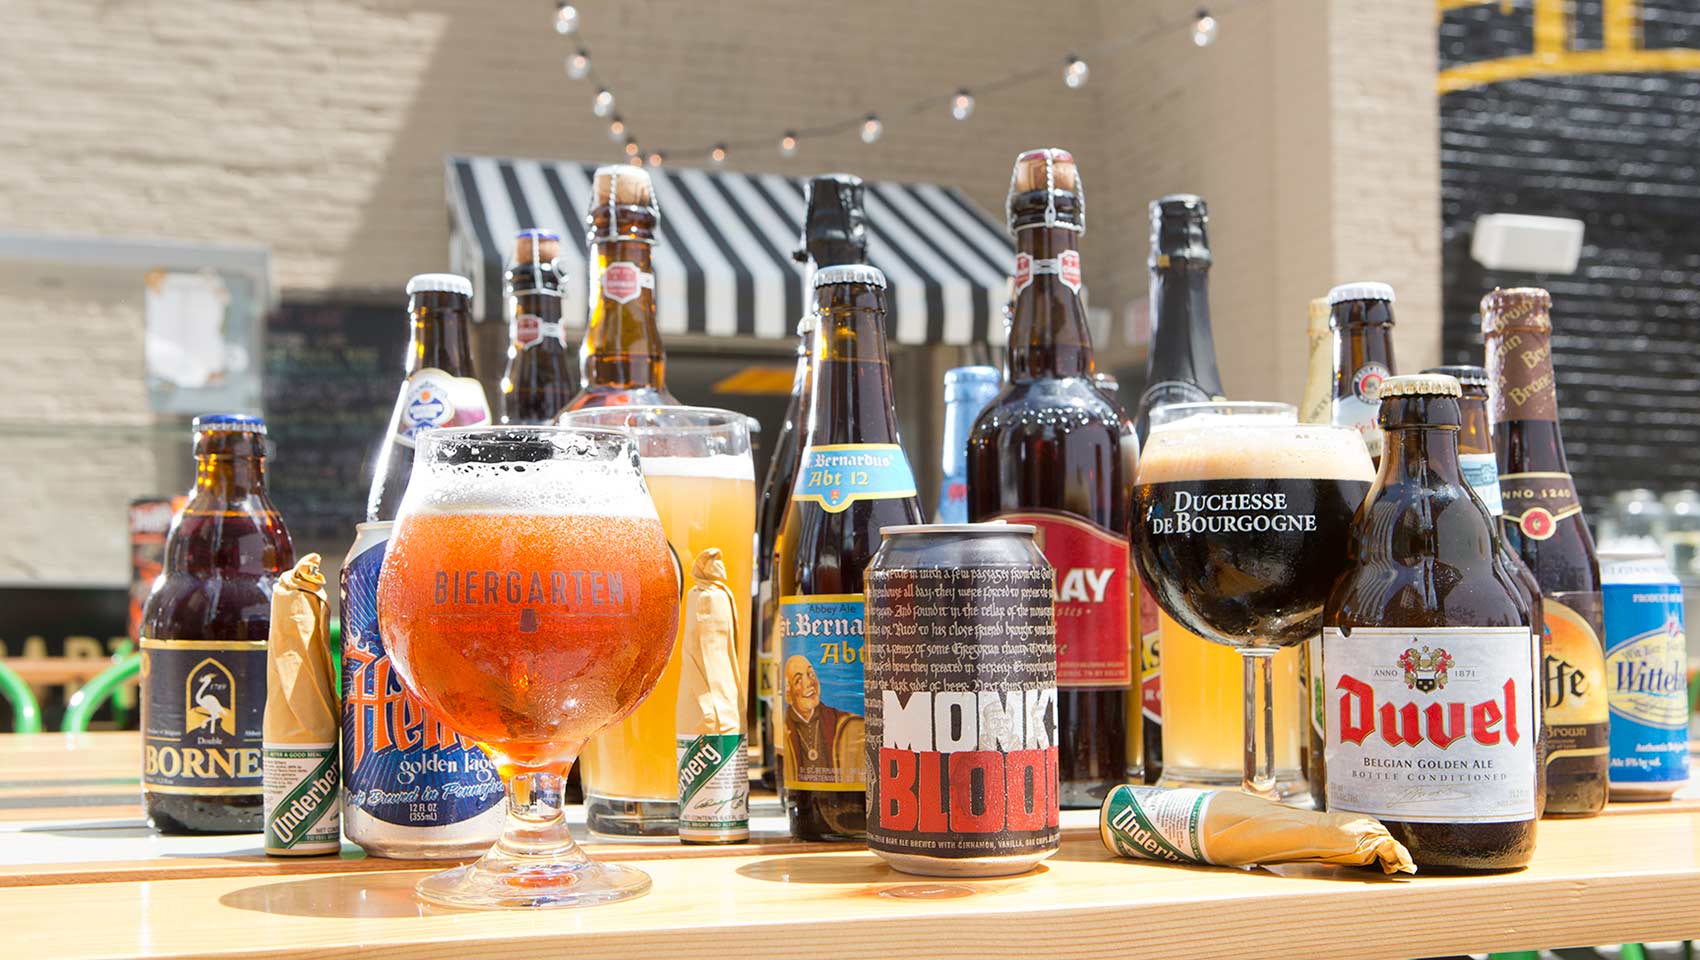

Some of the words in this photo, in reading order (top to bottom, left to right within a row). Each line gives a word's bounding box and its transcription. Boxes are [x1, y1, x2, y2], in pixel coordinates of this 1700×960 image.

[807, 470, 842, 487] Abt
[850, 472, 870, 486] 12
[1152, 517, 1174, 535] DE
[433, 570, 625, 605] BIERGARTEN
[808, 604, 837, 615] Abbey
[839, 603, 857, 614] Ale
[1374, 669, 1398, 678] ANNO
[1335, 674, 1520, 750] Duvel
[197, 736, 223, 745] Double
[144, 744, 264, 779] BORNE
[1363, 757, 1413, 769] BELGIAN
[1417, 759, 1468, 769] GOLDEN
[1472, 760, 1494, 769] ALE
[397, 753, 457, 785] golden
[1351, 770, 1399, 781] BOTTLE
[1407, 772, 1507, 782] CONDITIONED
[409, 803, 418, 812] 12
[427, 803, 438, 812] OZ
[938, 841, 956, 849] WITH
